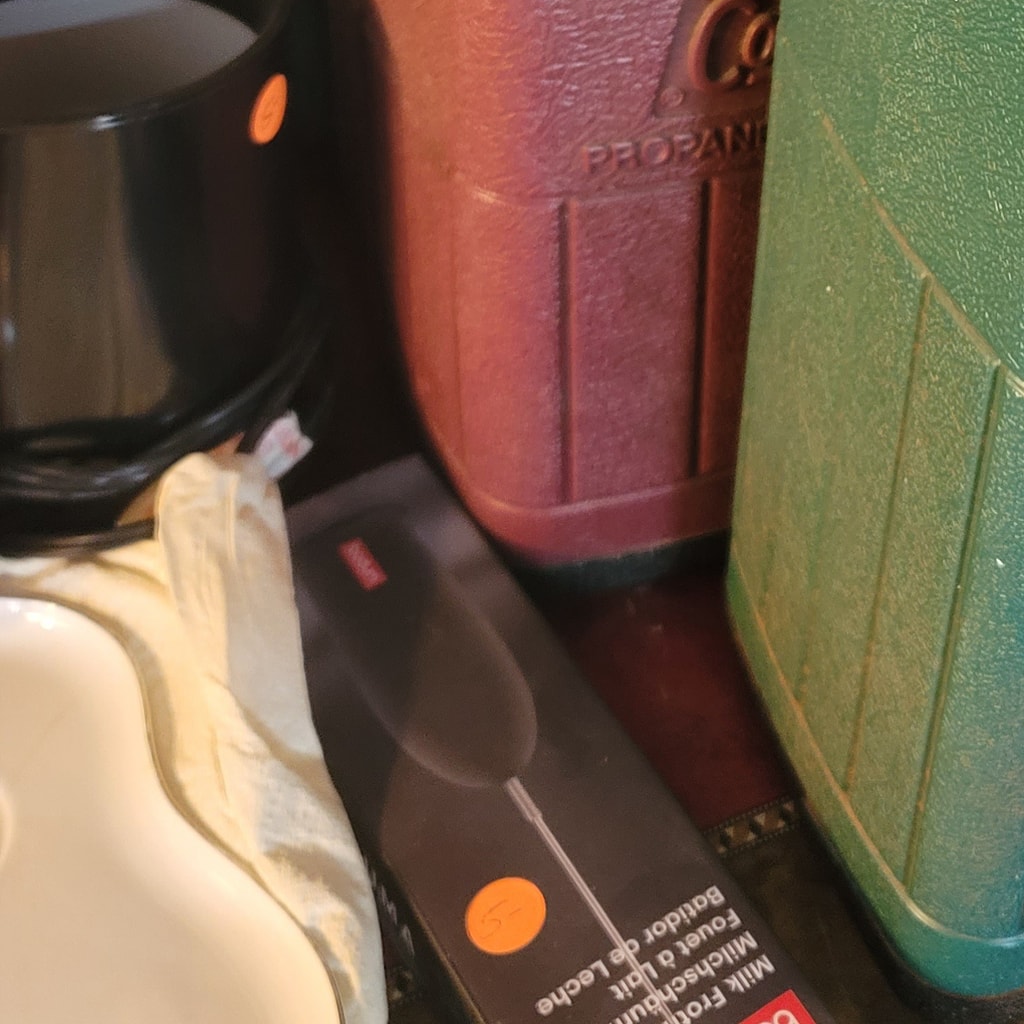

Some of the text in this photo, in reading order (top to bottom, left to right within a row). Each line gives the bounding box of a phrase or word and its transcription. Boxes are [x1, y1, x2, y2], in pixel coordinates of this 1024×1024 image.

[643, 885, 725, 944] Batidor
[608, 908, 742, 1000] Fouet à Lait
[722, 954, 776, 993] Milk
[535, 960, 610, 1016] Leche
[663, 985, 727, 1024] Frot
